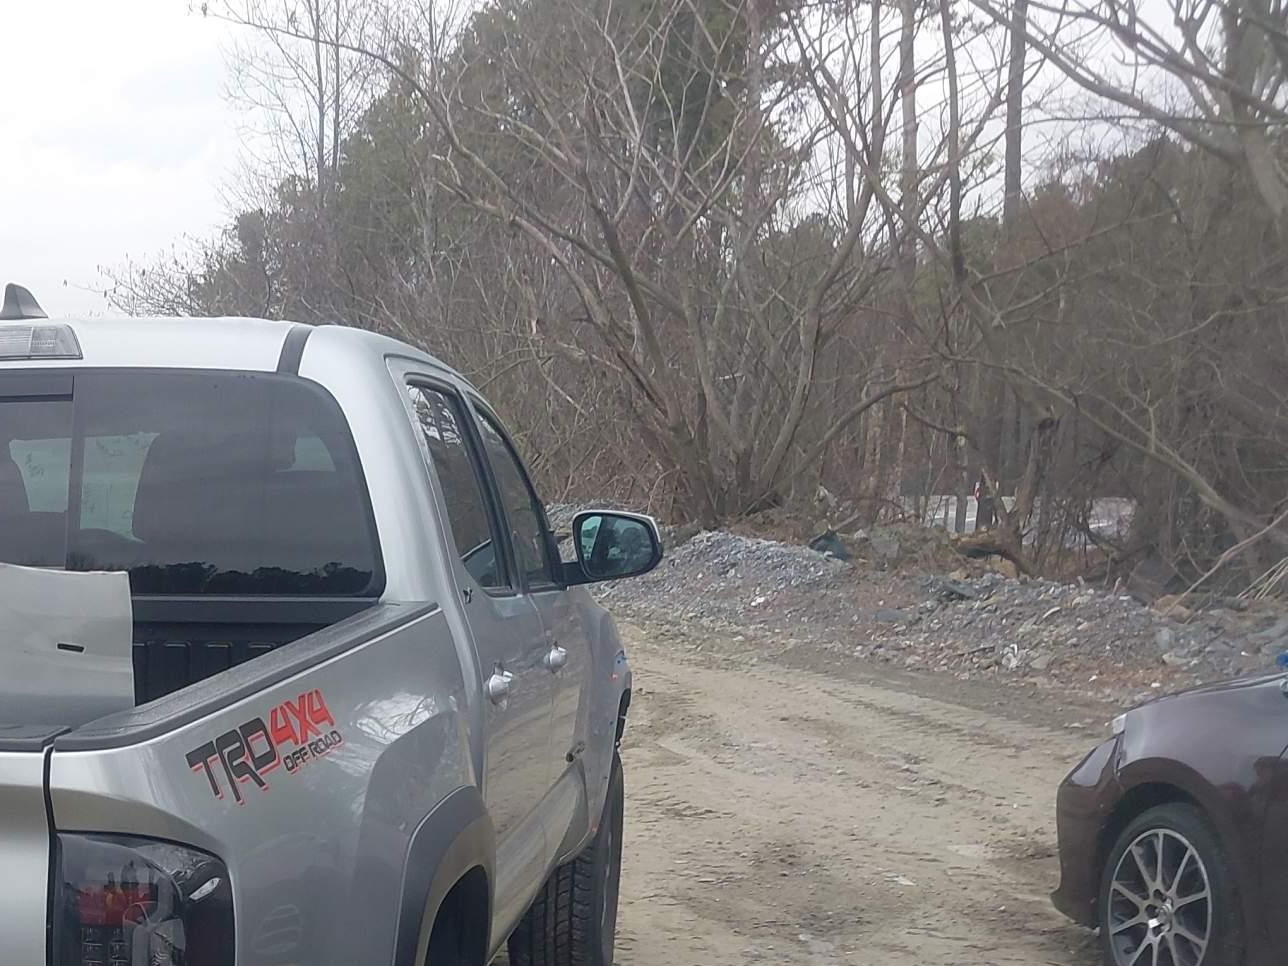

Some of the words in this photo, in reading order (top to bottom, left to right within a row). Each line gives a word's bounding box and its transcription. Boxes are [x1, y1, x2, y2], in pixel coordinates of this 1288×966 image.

[185, 717, 281, 806] TRD
[283, 748, 310, 774] OFF
[310, 730, 345, 759] ROAD
